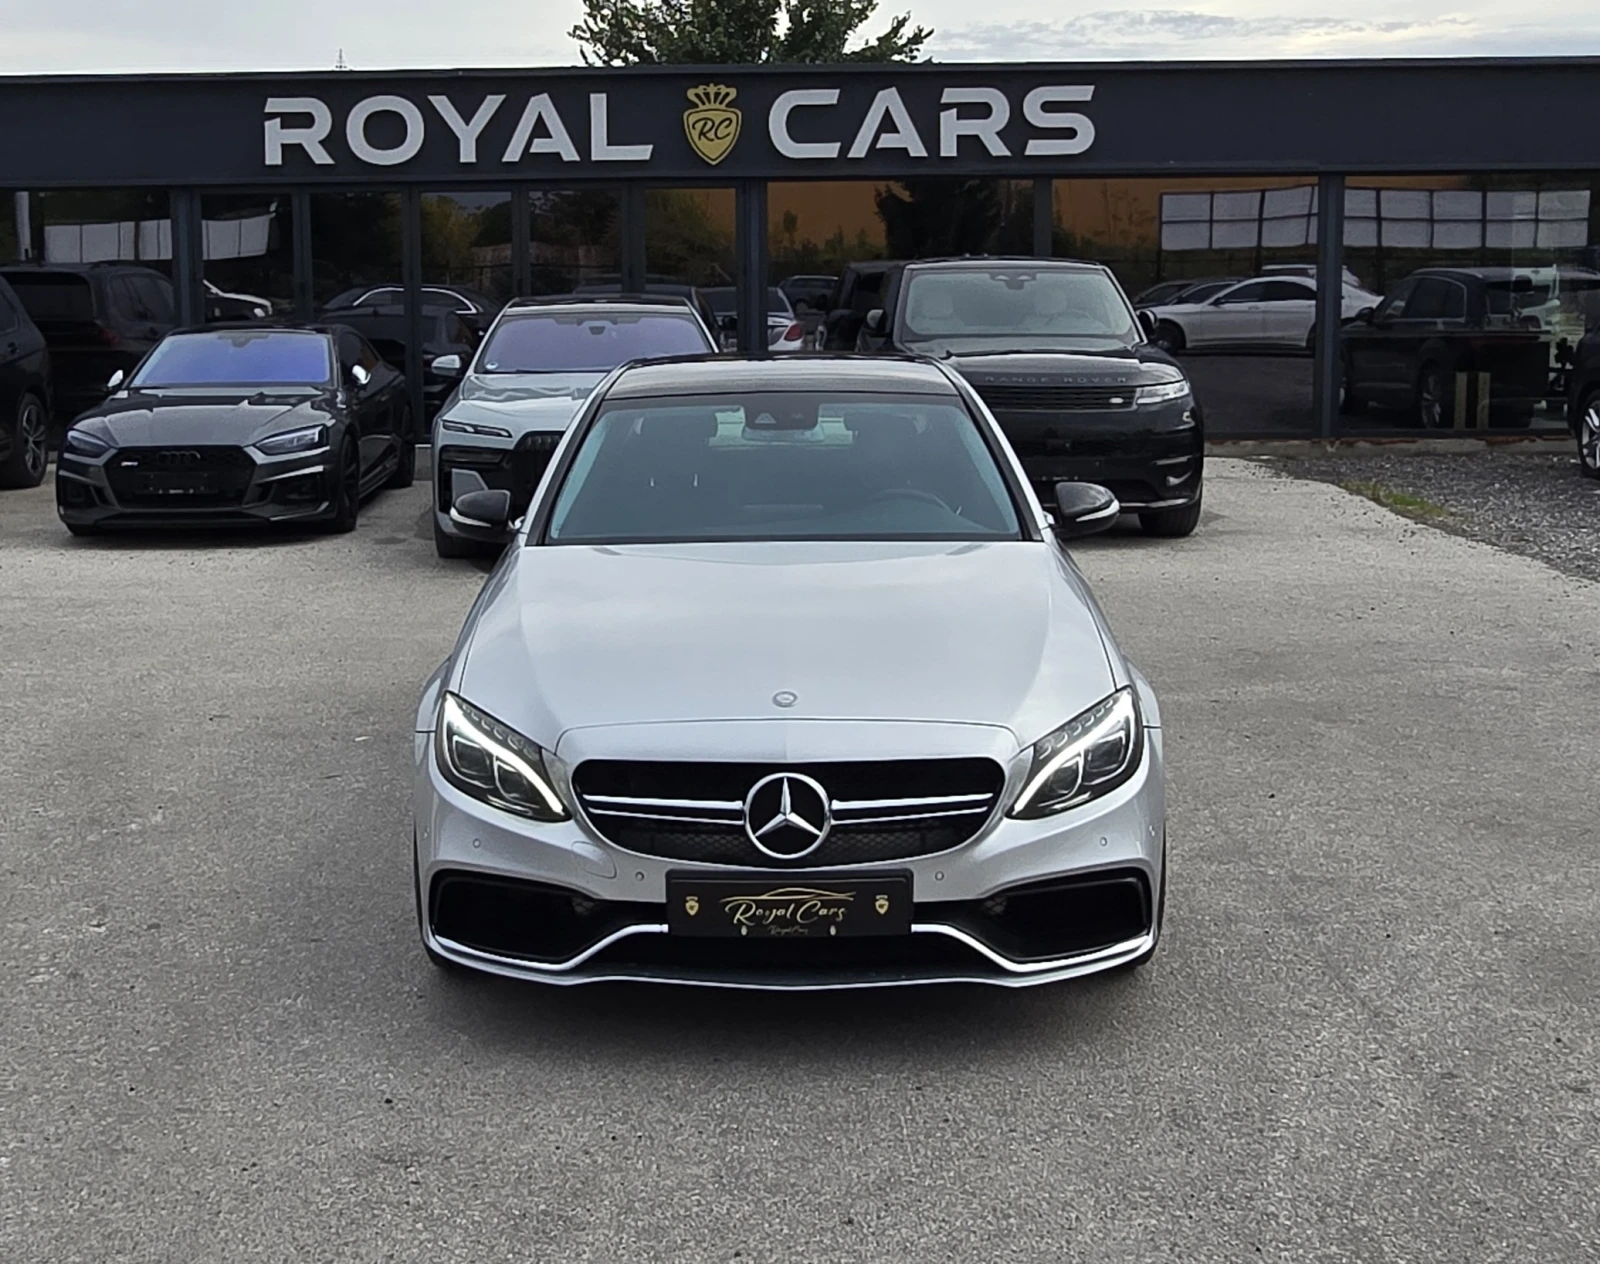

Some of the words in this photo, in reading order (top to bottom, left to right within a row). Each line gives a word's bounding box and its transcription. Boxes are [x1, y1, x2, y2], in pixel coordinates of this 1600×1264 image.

[264, 93, 654, 165] ROYAL
[768, 85, 1096, 159] CARS
[692, 117, 733, 142] RC
[725, 900, 795, 926] Royal
[796, 900, 846, 924] Cars
